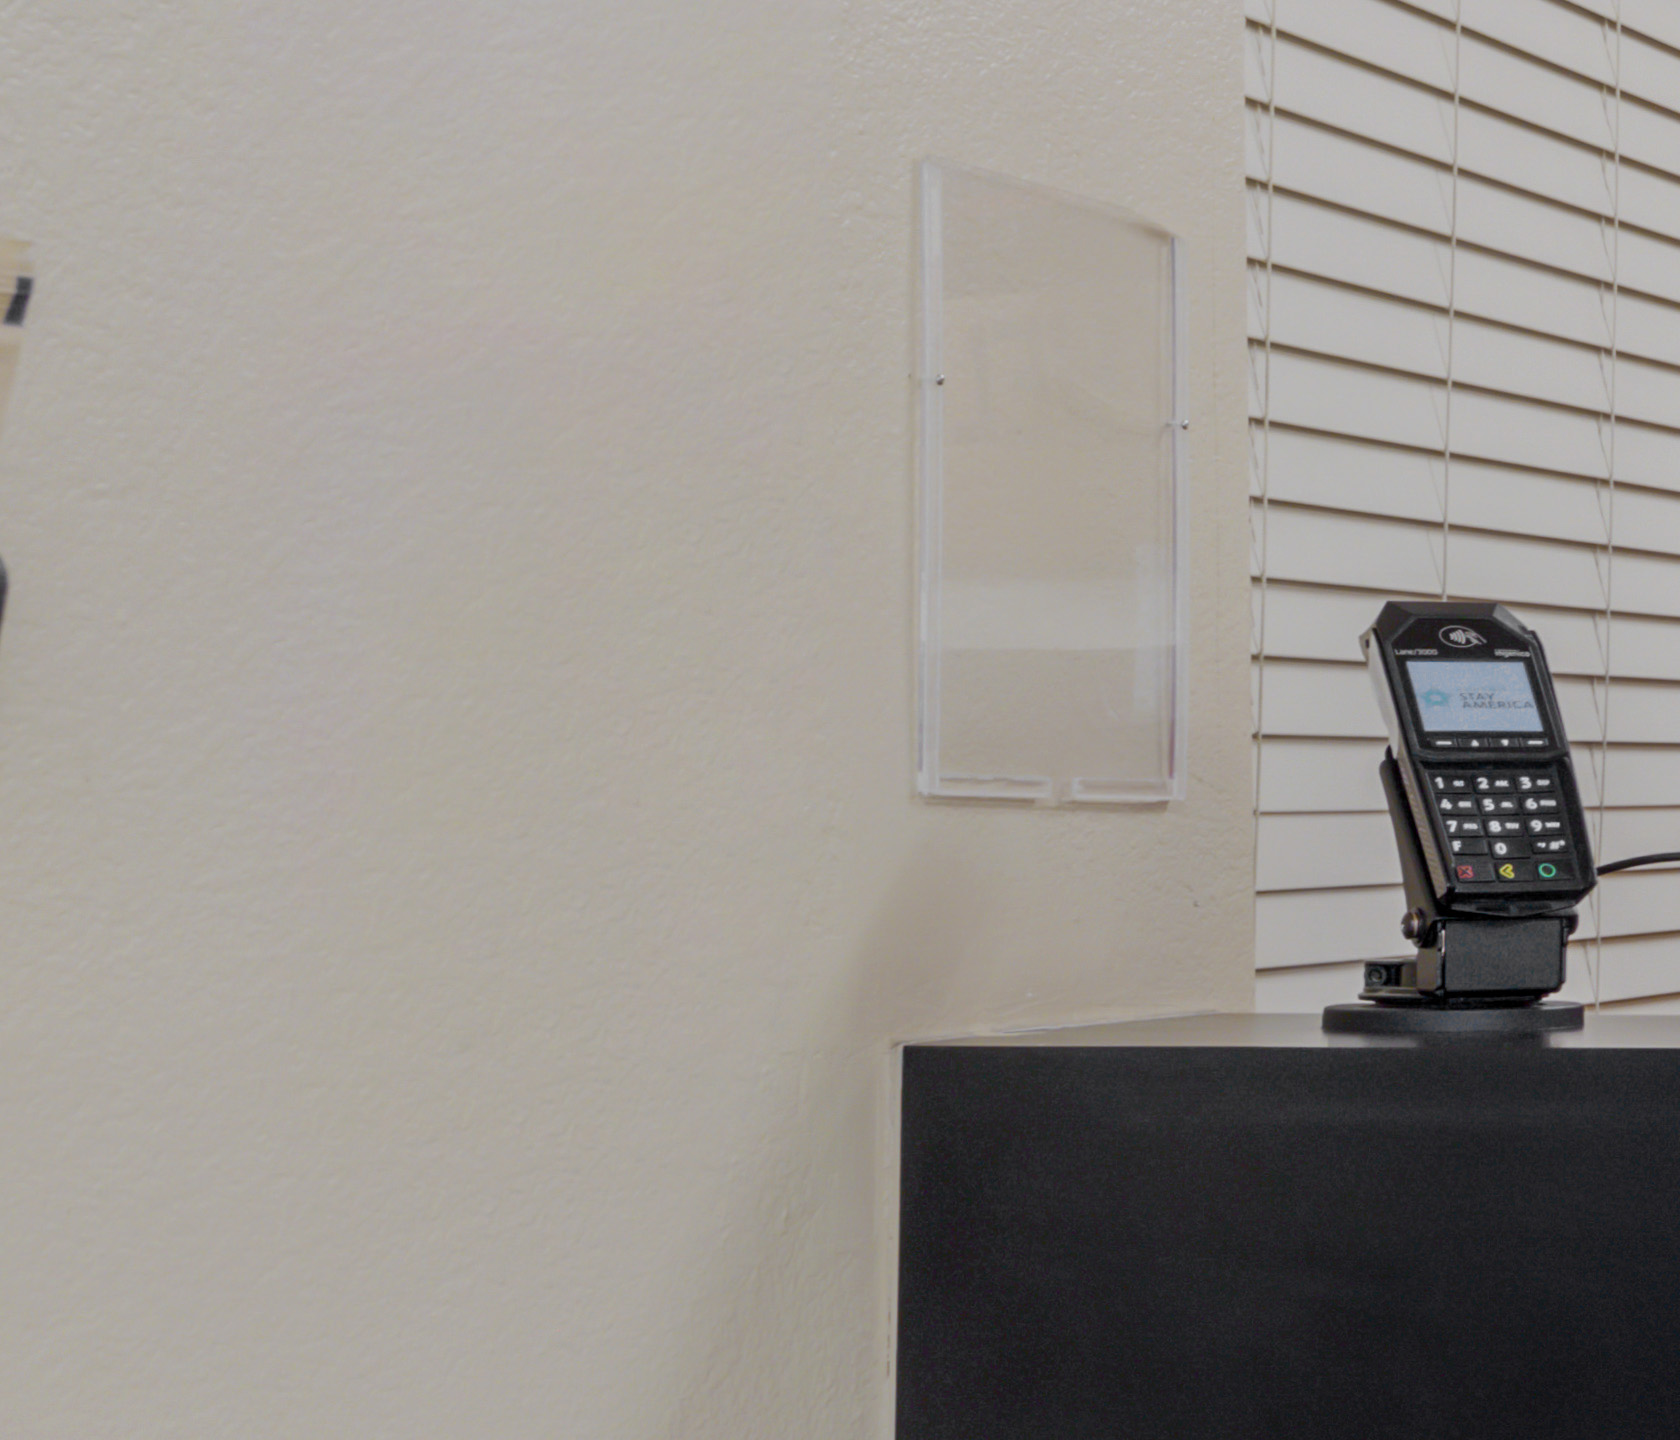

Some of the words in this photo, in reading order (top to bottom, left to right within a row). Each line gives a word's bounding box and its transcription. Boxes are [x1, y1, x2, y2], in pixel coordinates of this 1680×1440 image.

[1459, 692, 1495, 701] STAY
[1462, 701, 1534, 709] AMERICA
[1434, 776, 1444, 789] 1
[1477, 776, 1490, 789] 2
[1519, 776, 1532, 790] 3
[1440, 798, 1453, 810] 4
[1482, 798, 1495, 811] 5
[1525, 798, 1538, 810] 6
[1446, 820, 1458, 833] 7
[1488, 820, 1501, 833] 8
[1530, 819, 1542, 832] 9
